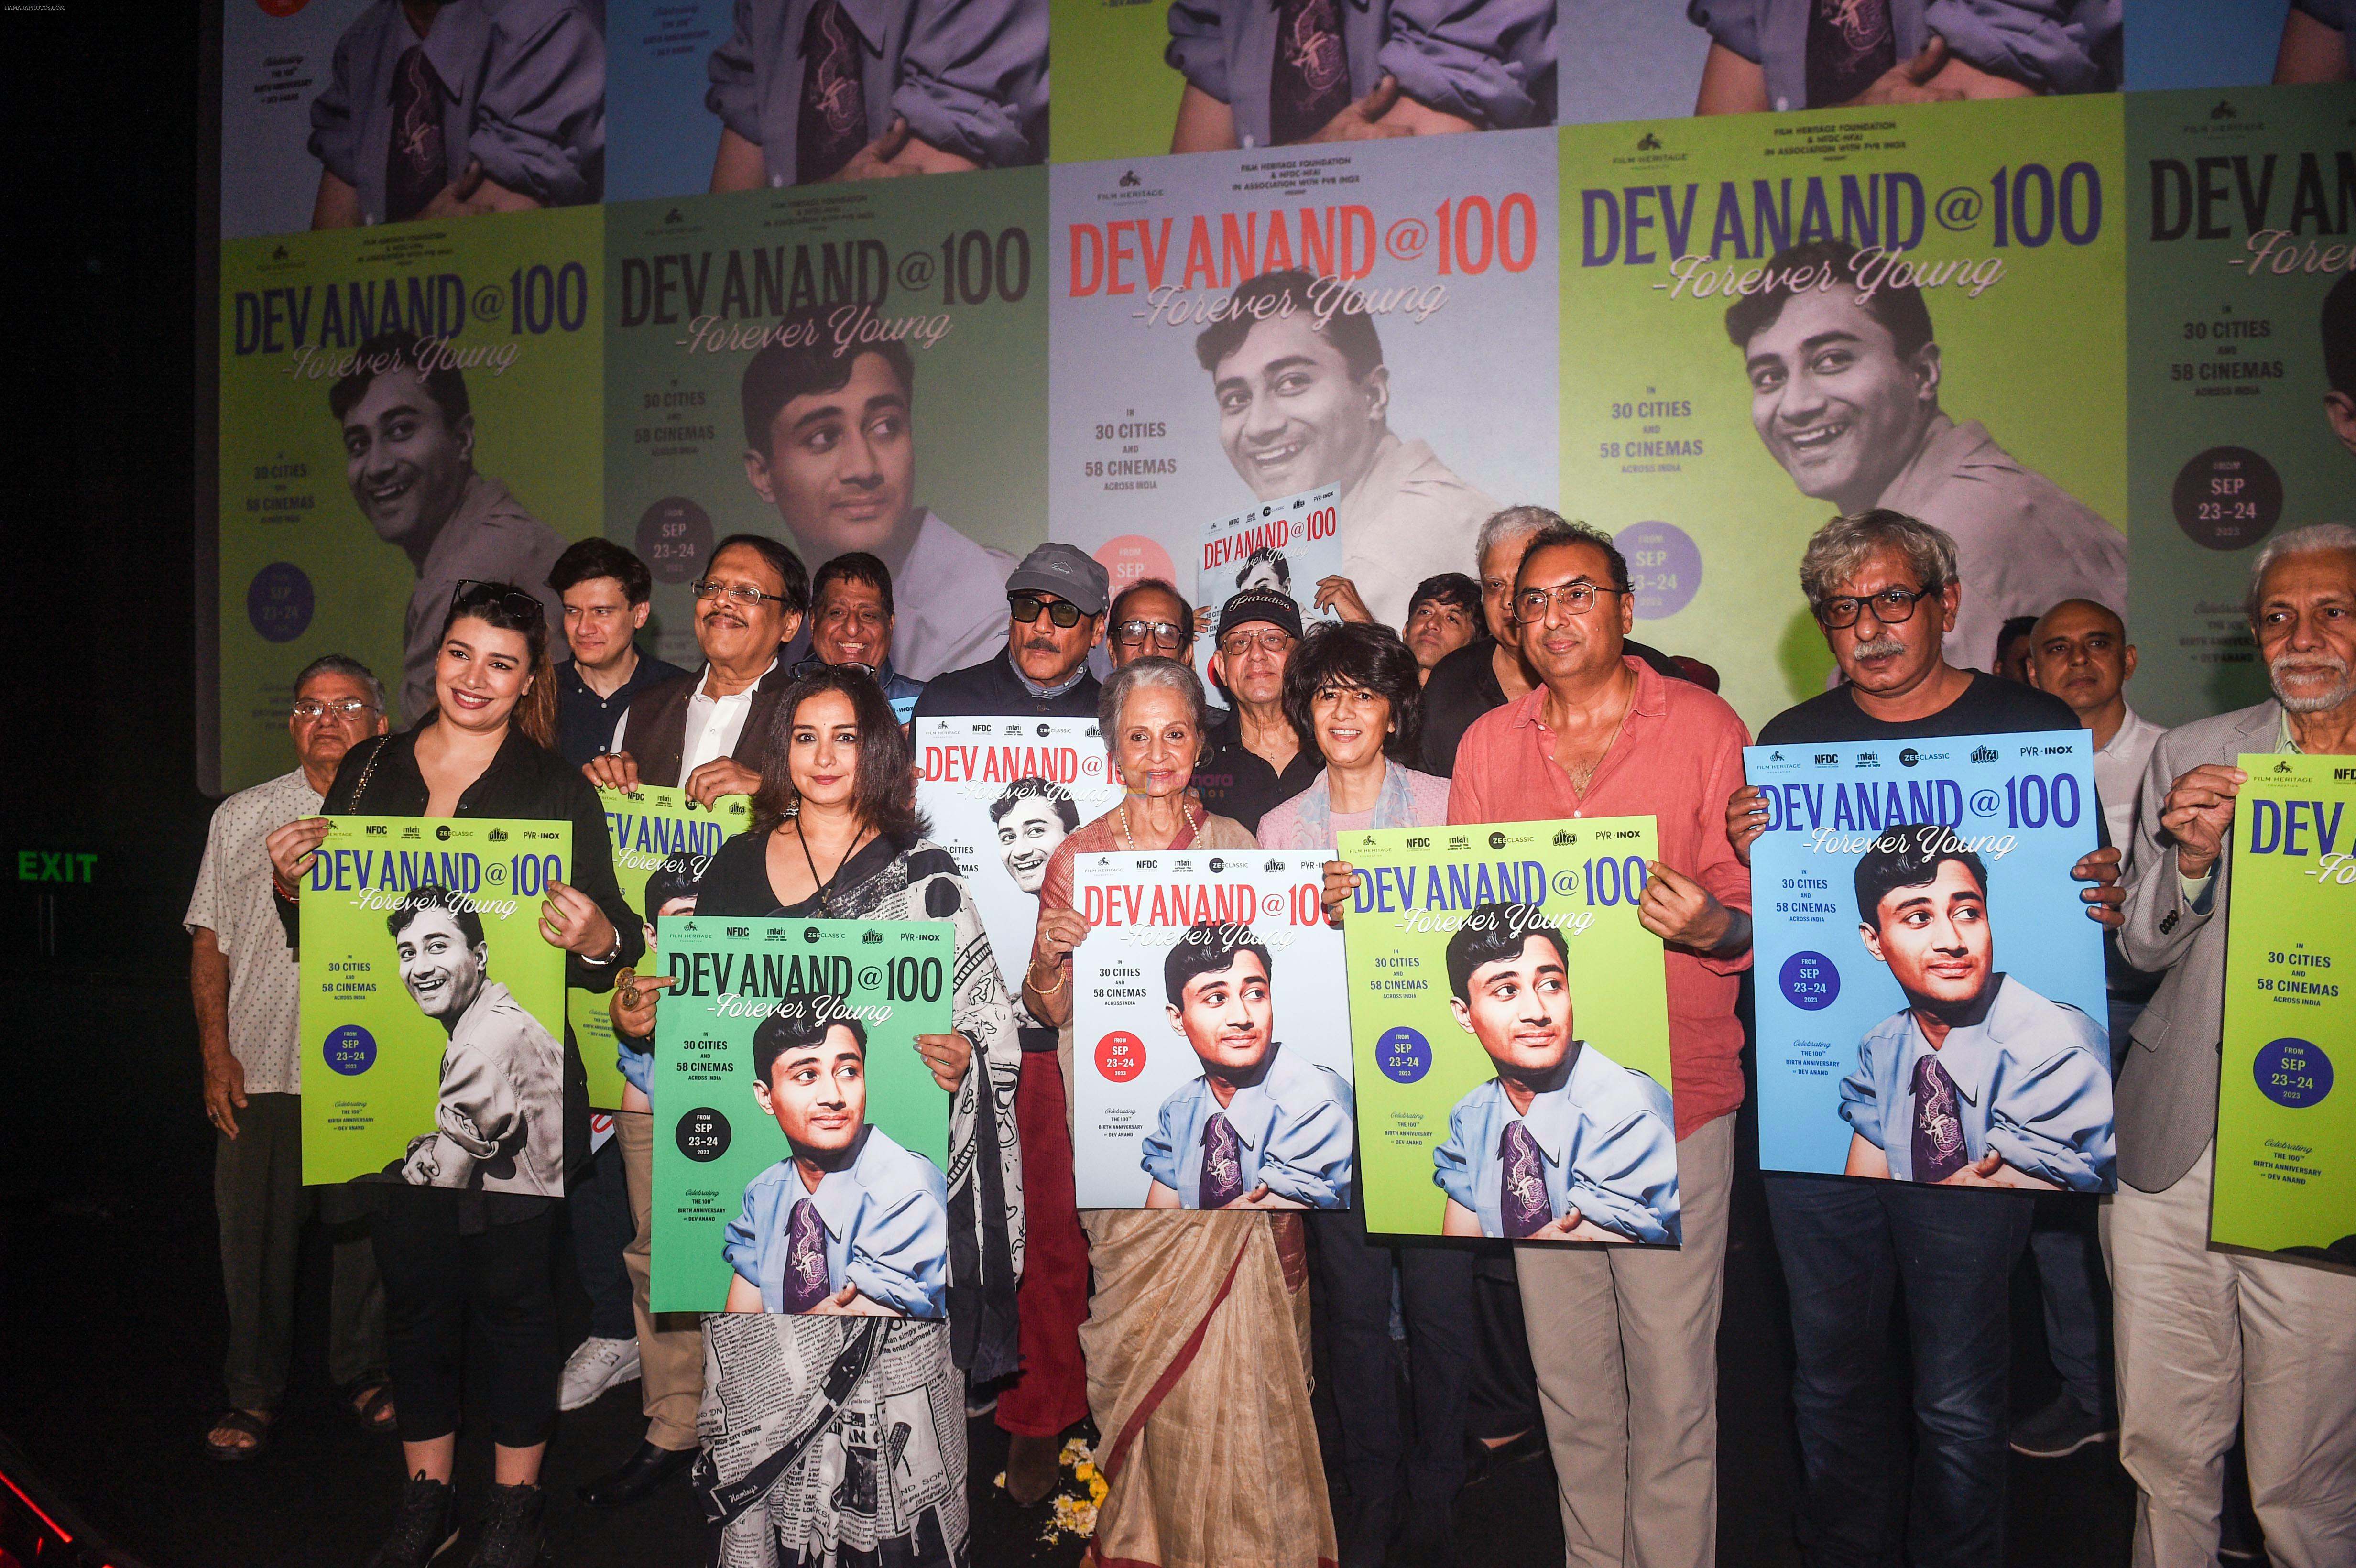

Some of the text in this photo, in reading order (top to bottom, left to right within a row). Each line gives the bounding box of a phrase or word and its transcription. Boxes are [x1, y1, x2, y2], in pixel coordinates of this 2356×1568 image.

[2149, 153, 2278, 240] DEV
[1581, 184, 1699, 267] DEV
[1710, 172, 1926, 261] ANAND
[1069, 217, 1174, 298] DEV
[1183, 204, 1376, 290] ANAND
[621, 239, 889, 327] DEV ANAND
[1849, 245, 2007, 305] Young
[1306, 274, 1449, 330] Young
[235, 273, 465, 355] DEV ANAND
[827, 305, 953, 358] Young
[2184, 320, 2271, 340] 30 CITIES
[412, 335, 520, 382] Young
[2171, 360, 2284, 381] 58 CINEMAS
[643, 391, 706, 409] 30 CITIES
[1612, 400, 1691, 419] 30 CITIES
[654, 425, 714, 442] CINEMAS
[1096, 422, 1166, 440] 30 CITIES
[1600, 439, 1703, 458] 58 CINEMAS
[1085, 459, 1176, 477] 58 CINEMAS
[2211, 478, 2244, 495] SEP
[2199, 502, 2256, 520] 23-24
[1204, 520, 1288, 570] DEV ANAND
[1117, 563, 1144, 577] SEP
[925, 746, 1078, 784] DEV ANAND
[1815, 754, 1838, 764] NFDC
[627, 792, 644, 800] NFDC
[1044, 781, 1110, 807] Young
[1759, 783, 1825, 831] DEV
[1834, 779, 1963, 830] ANAND
[366, 826, 387, 834] NFDC
[2250, 799, 2345, 857] DEV
[1407, 838, 1430, 848] NFDC
[1916, 823, 2018, 863] Young
[18, 851, 98, 883] EXIT
[311, 850, 480, 894] DEV ANAND
[1353, 866, 1416, 914] DEV
[1421, 861, 1547, 910] ANAND
[1782, 879, 1827, 889] 30 CITIES
[445, 890, 518, 920] Young
[1084, 884, 1256, 927] DEV ANAND
[1777, 903, 1836, 913] 58 CINEMAS
[1503, 904, 1595, 939] Young
[727, 927, 749, 936] NFDC
[1218, 922, 1296, 953] Young
[343, 963, 370, 971] CITIES
[1375, 958, 1419, 967] 30 CITIES
[2268, 952, 2331, 968] 30 CITIES
[668, 952, 735, 996] DEV
[739, 954, 853, 999] ANAND
[1100, 968, 1140, 977] 30 CITIES
[1800, 969, 1819, 979] SEP
[322, 983, 376, 992] 58 CINEMAS
[1094, 989, 1146, 997] 58 CINEMAS
[1371, 980, 1428, 990] 58 CINEMAS
[1794, 982, 1826, 993] 23-24
[2258, 979, 2338, 997] 58 CINEMAS
[811, 994, 894, 1028] Young
[342, 1040, 359, 1048] SEP
[684, 1041, 727, 1050] 30 CITIES
[1112, 1046, 1128, 1055] SEP
[1395, 1044, 1412, 1053] SEP
[337, 1052, 364, 1060] 23-24
[1107, 1058, 1134, 1067] 23-24
[1389, 1057, 1419, 1067] 23-24
[2281, 1058, 2306, 1071] SEP
[677, 1063, 733, 1072] 58 CINEMAS
[2272, 1073, 2313, 1089] 23-24
[695, 1124, 712, 1132] SEP
[689, 1137, 718, 1145] 23-24
[893, 1329, 931, 1353] entertainment
[899, 1326, 916, 1340] simply
